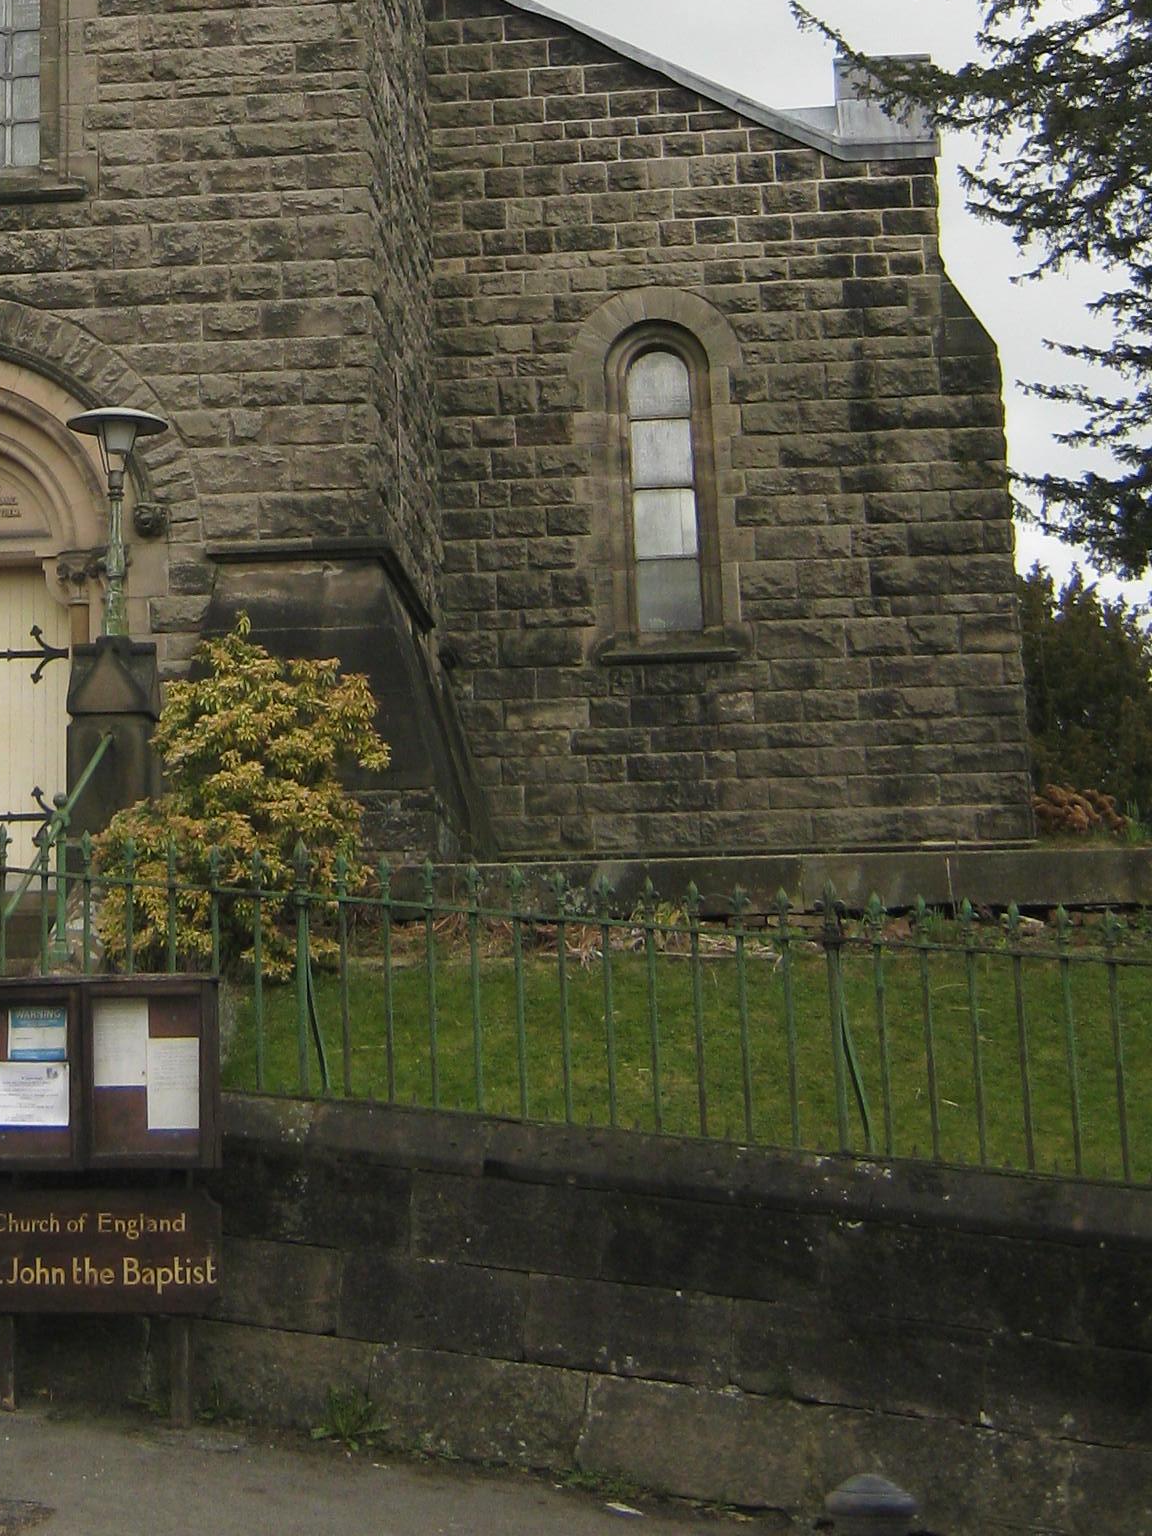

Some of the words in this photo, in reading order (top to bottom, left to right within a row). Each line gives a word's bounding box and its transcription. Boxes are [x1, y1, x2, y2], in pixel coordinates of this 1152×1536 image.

[16, 1009, 61, 1019] WARNING
[67, 1213, 87, 1233] of
[98, 1213, 186, 1240] England
[6, 1257, 66, 1285] John
[72, 1257, 115, 1285] the
[123, 1256, 217, 1295] Baptist
